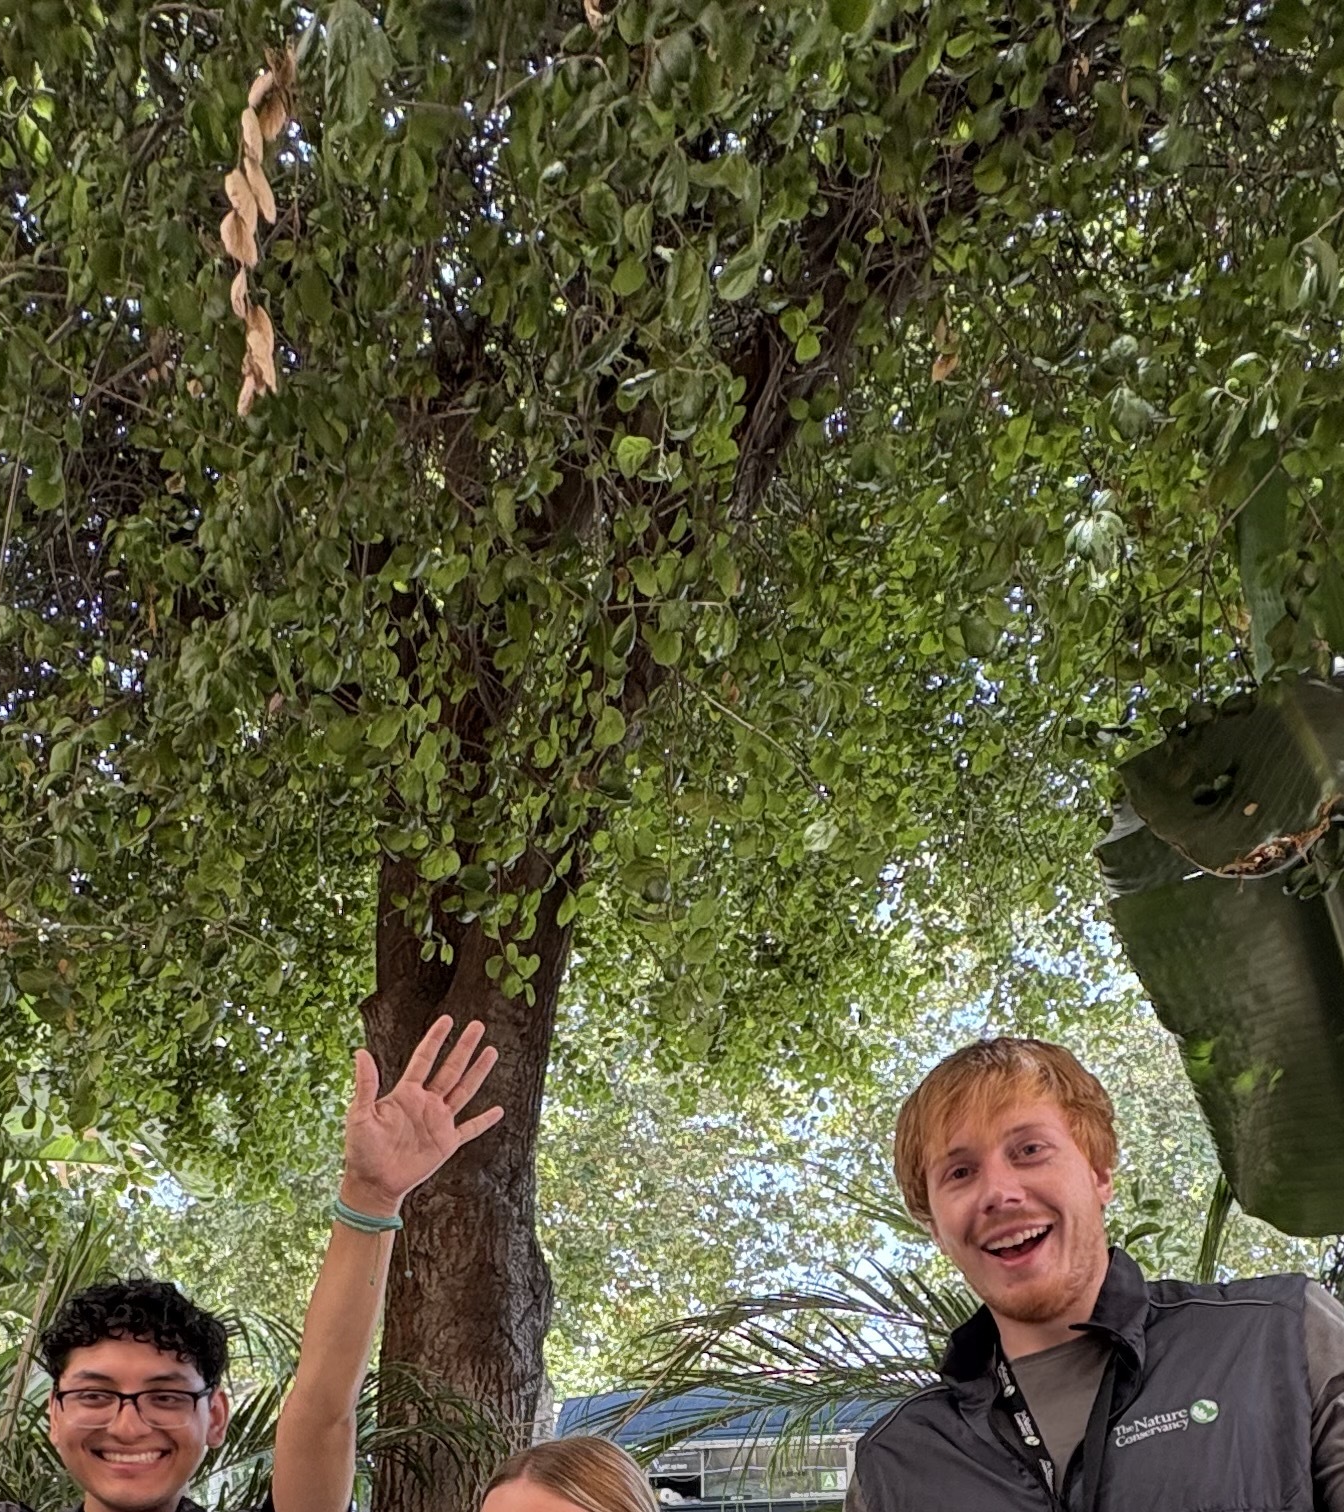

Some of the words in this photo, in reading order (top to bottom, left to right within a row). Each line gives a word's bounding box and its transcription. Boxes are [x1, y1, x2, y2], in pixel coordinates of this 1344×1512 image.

[1114, 1424, 1134, 1436] The
[1134, 1409, 1188, 1432] Nature
[1115, 1418, 1189, 1447] Conservancy
